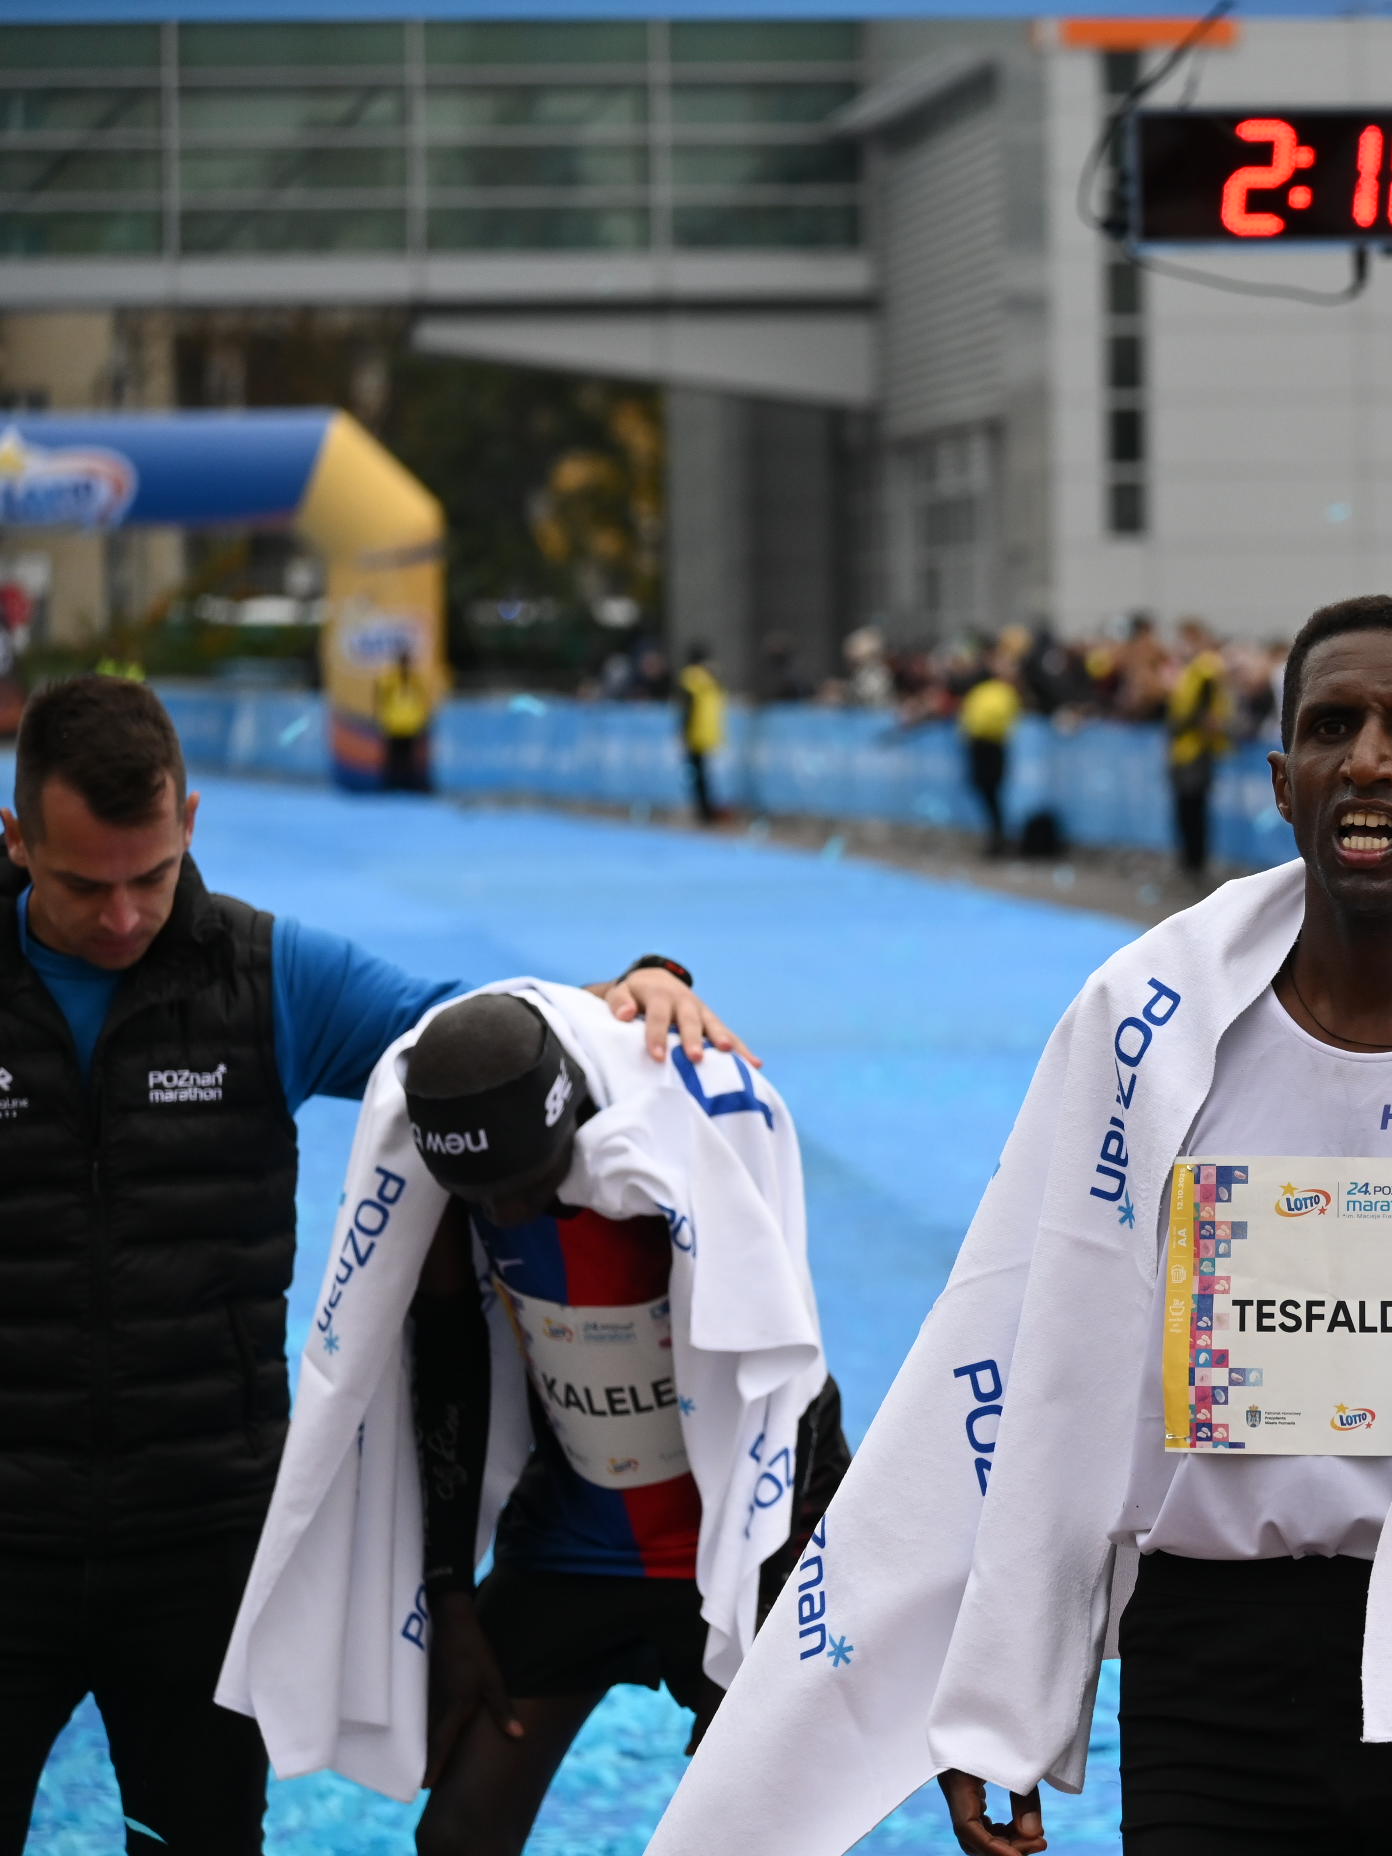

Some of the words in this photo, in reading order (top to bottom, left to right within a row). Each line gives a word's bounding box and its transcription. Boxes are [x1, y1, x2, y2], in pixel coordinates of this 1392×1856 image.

[149, 1086, 222, 1103] marathon
[1285, 1194, 1321, 1212] LOTTO
[541, 1372, 680, 1417] KALELE
[1339, 1412, 1368, 1427] LOTTO
